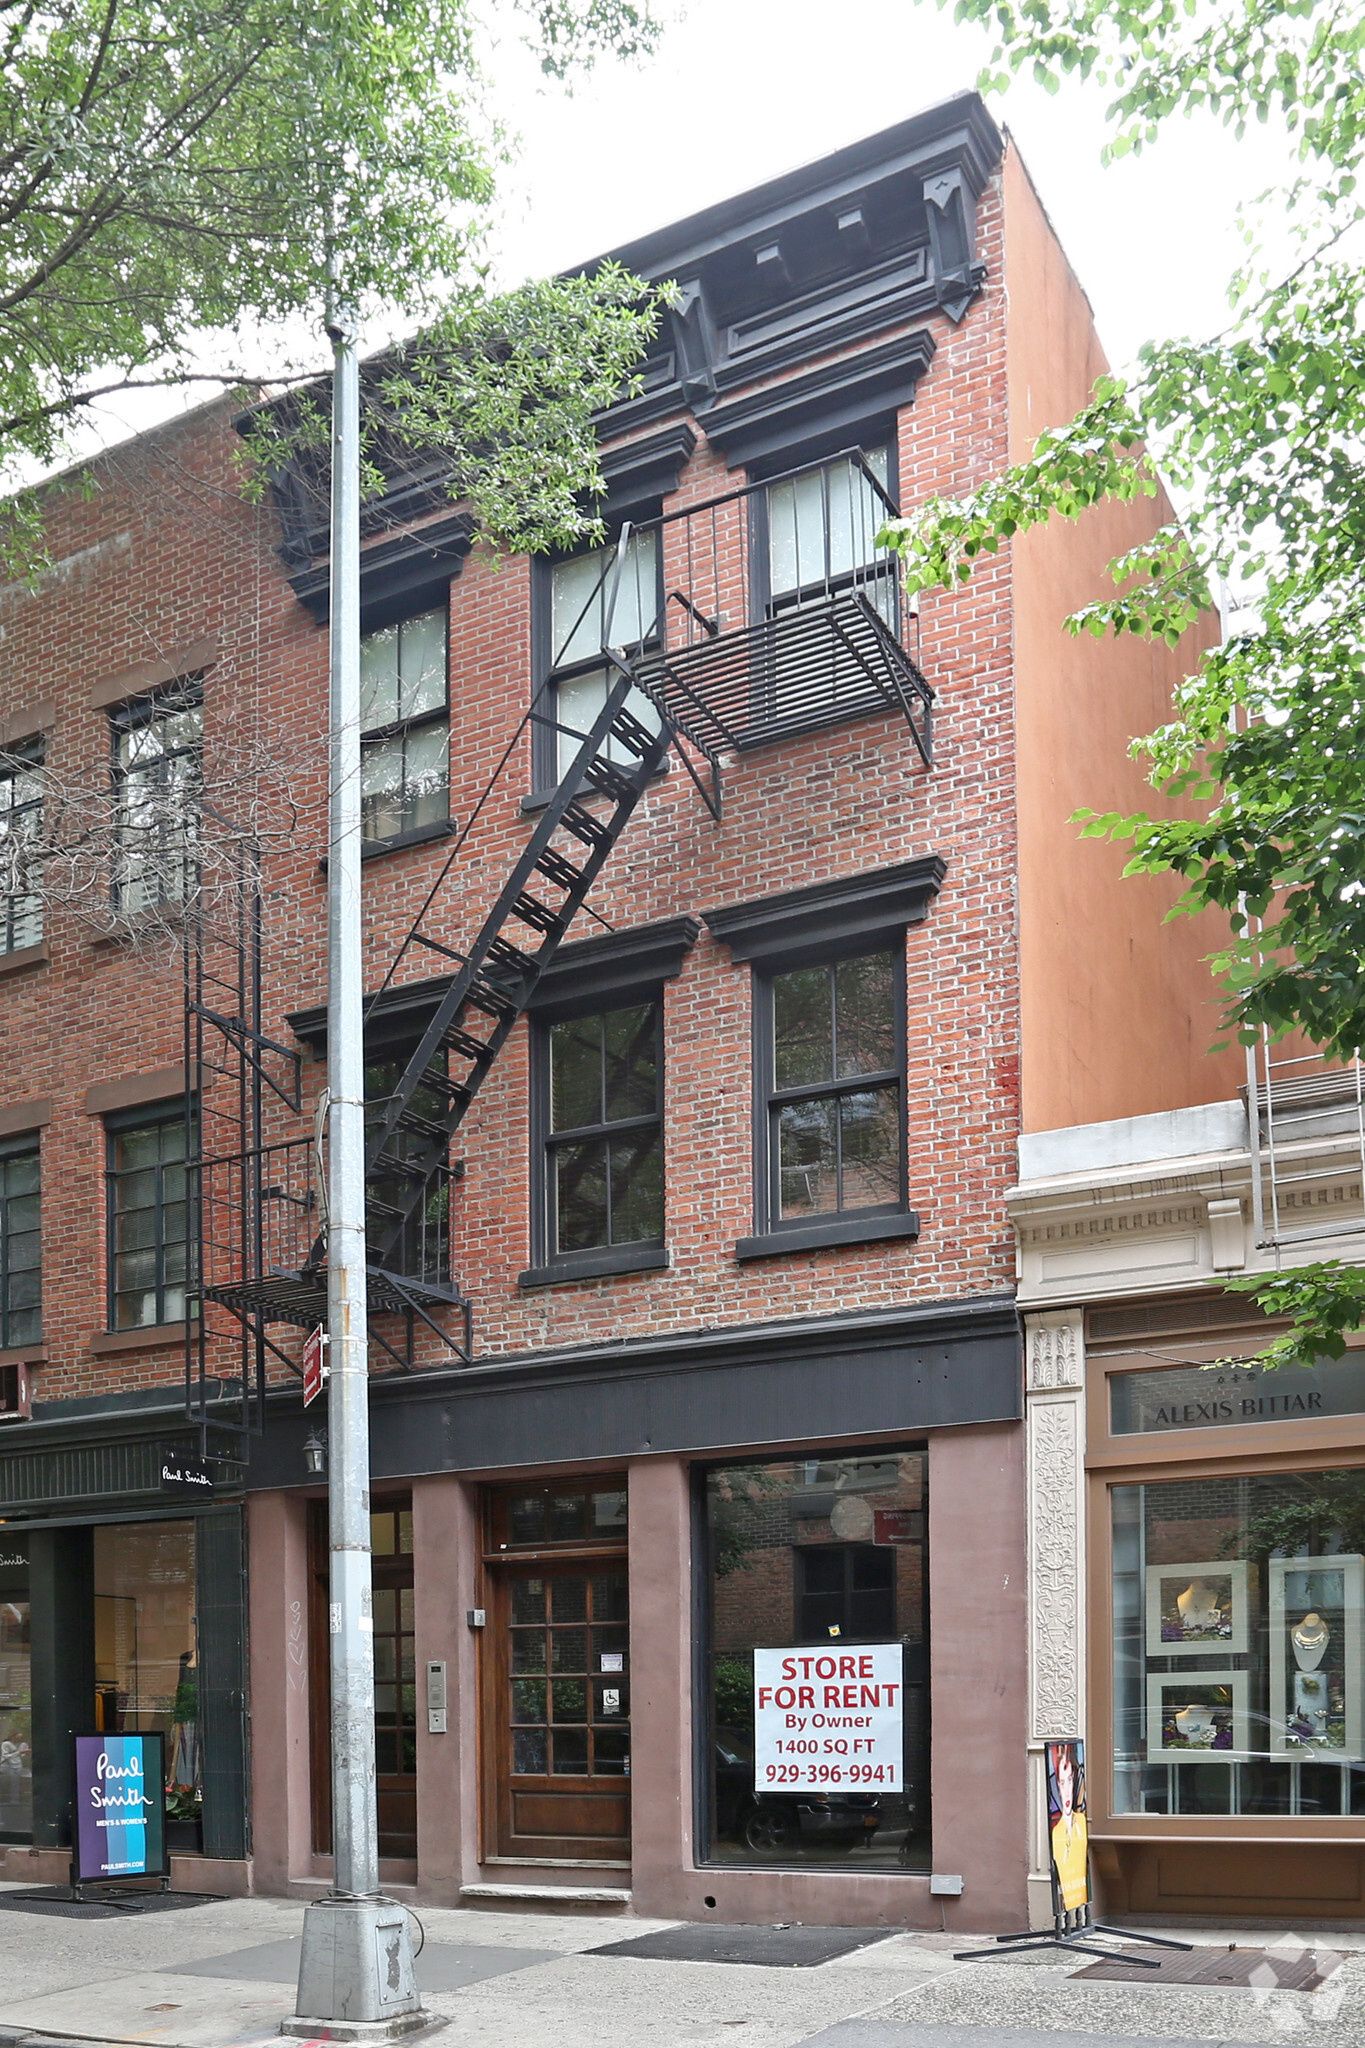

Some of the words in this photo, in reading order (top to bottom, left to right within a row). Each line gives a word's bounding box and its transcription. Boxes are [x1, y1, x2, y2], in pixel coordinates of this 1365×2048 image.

[1155, 1400, 1233, 1425] ALEXIS
[1241, 1391, 1323, 1417] BITTAR
[162, 1465, 183, 1481] Paul
[185, 1470, 213, 1486] Smith
[781, 1655, 874, 1681] STORE
[758, 1685, 815, 1710] FOR
[824, 1683, 900, 1708] RENT
[785, 1714, 808, 1732] By
[811, 1713, 873, 1728] Owner
[775, 1739, 819, 1754] 1400
[823, 1739, 849, 1755] SQ
[853, 1738, 876, 1754] FT
[96, 1752, 145, 1781] Paul
[765, 1764, 895, 1784] 929-396-9941
[90, 1786, 154, 1808] Smith
[96, 1819, 115, 1827] MEN'S
[120, 1817, 148, 1825] WOMEN'S
[101, 1861, 144, 1870] PAULSMITH.COM
